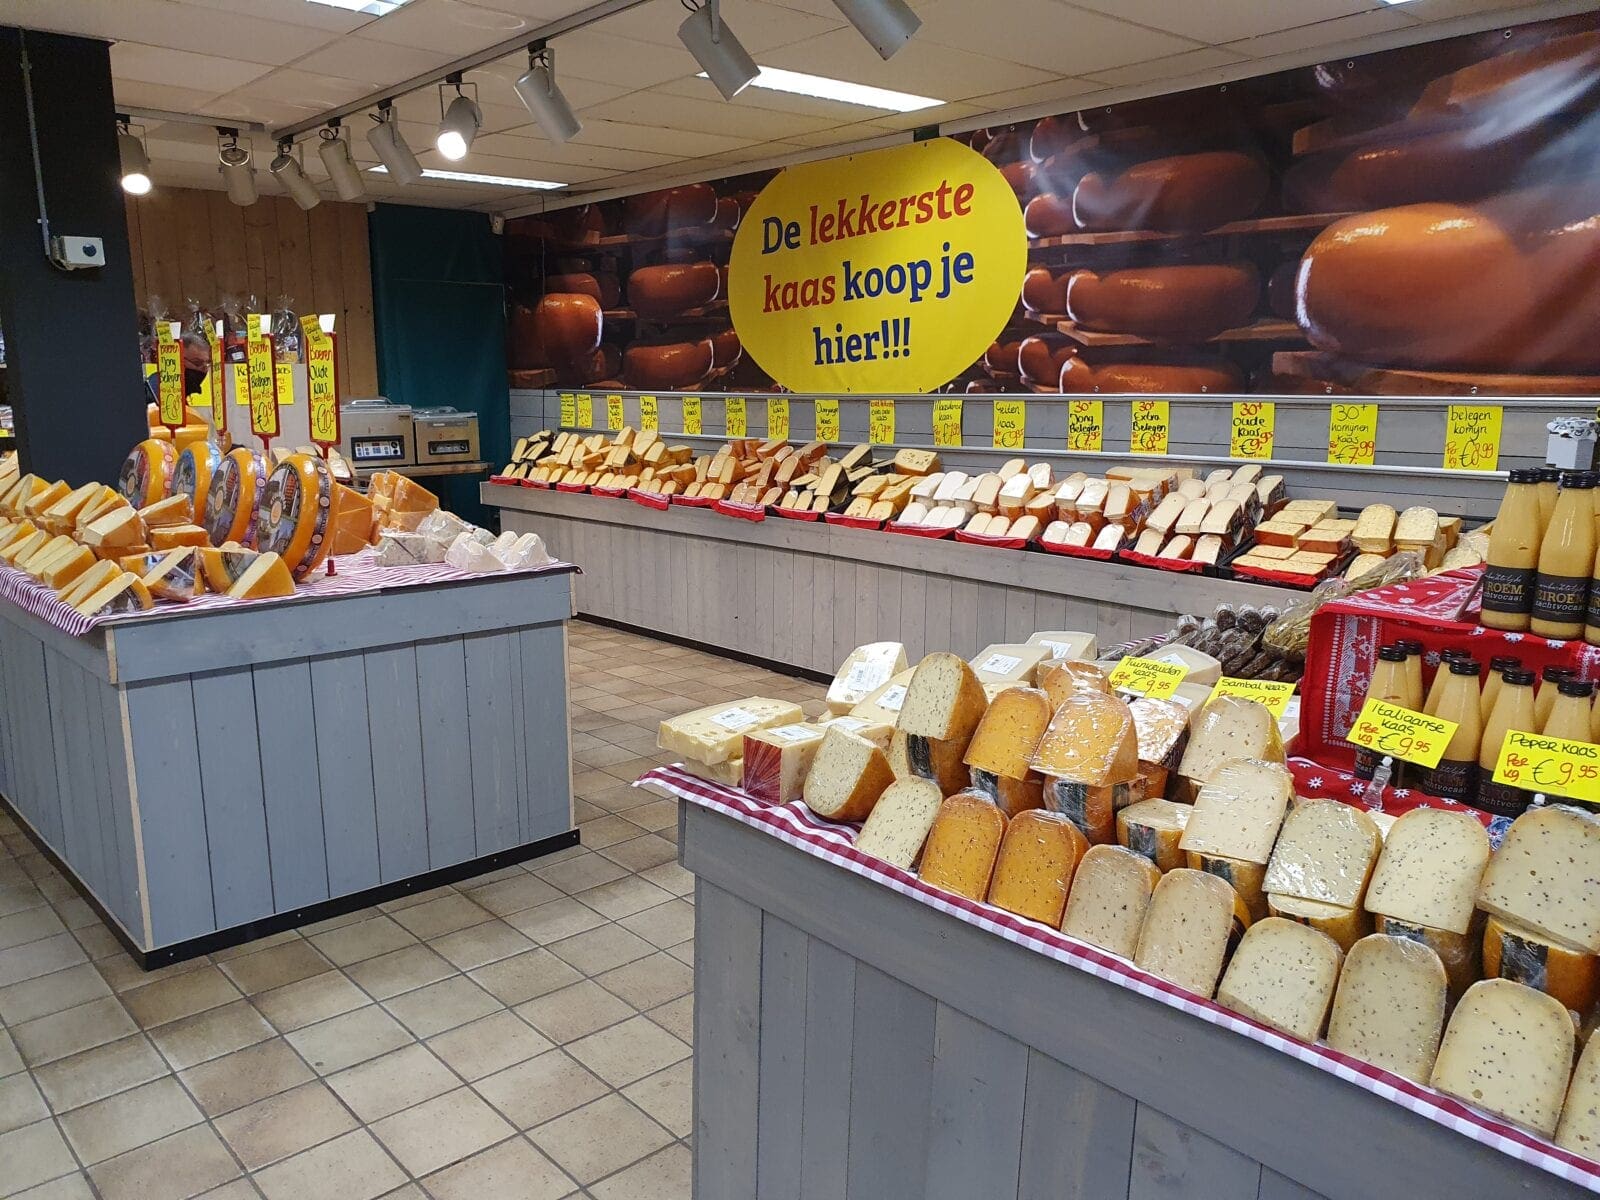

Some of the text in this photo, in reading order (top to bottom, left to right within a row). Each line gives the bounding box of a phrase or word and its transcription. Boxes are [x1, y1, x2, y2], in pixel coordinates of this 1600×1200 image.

[762, 180, 974, 254] De lekkerste
[763, 242, 974, 313] kaas koop je
[813, 317, 911, 365] hier!!!
[1133, 411, 1160, 421] Extra
[1240, 402, 1263, 416] 30+
[1334, 404, 1369, 421] 30+
[1450, 405, 1492, 427] belegen
[1070, 413, 1094, 425] Jong
[1132, 421, 1166, 436] Belegen
[1133, 668, 1157, 679] kaas
[1222, 678, 1262, 691] Sambal
[1371, 703, 1446, 735] Italiaanse
[1382, 719, 1415, 736] kaas
[1358, 733, 1373, 745] kg
[1562, 741, 1598, 759] kaas
[1503, 768, 1521, 782] kg
